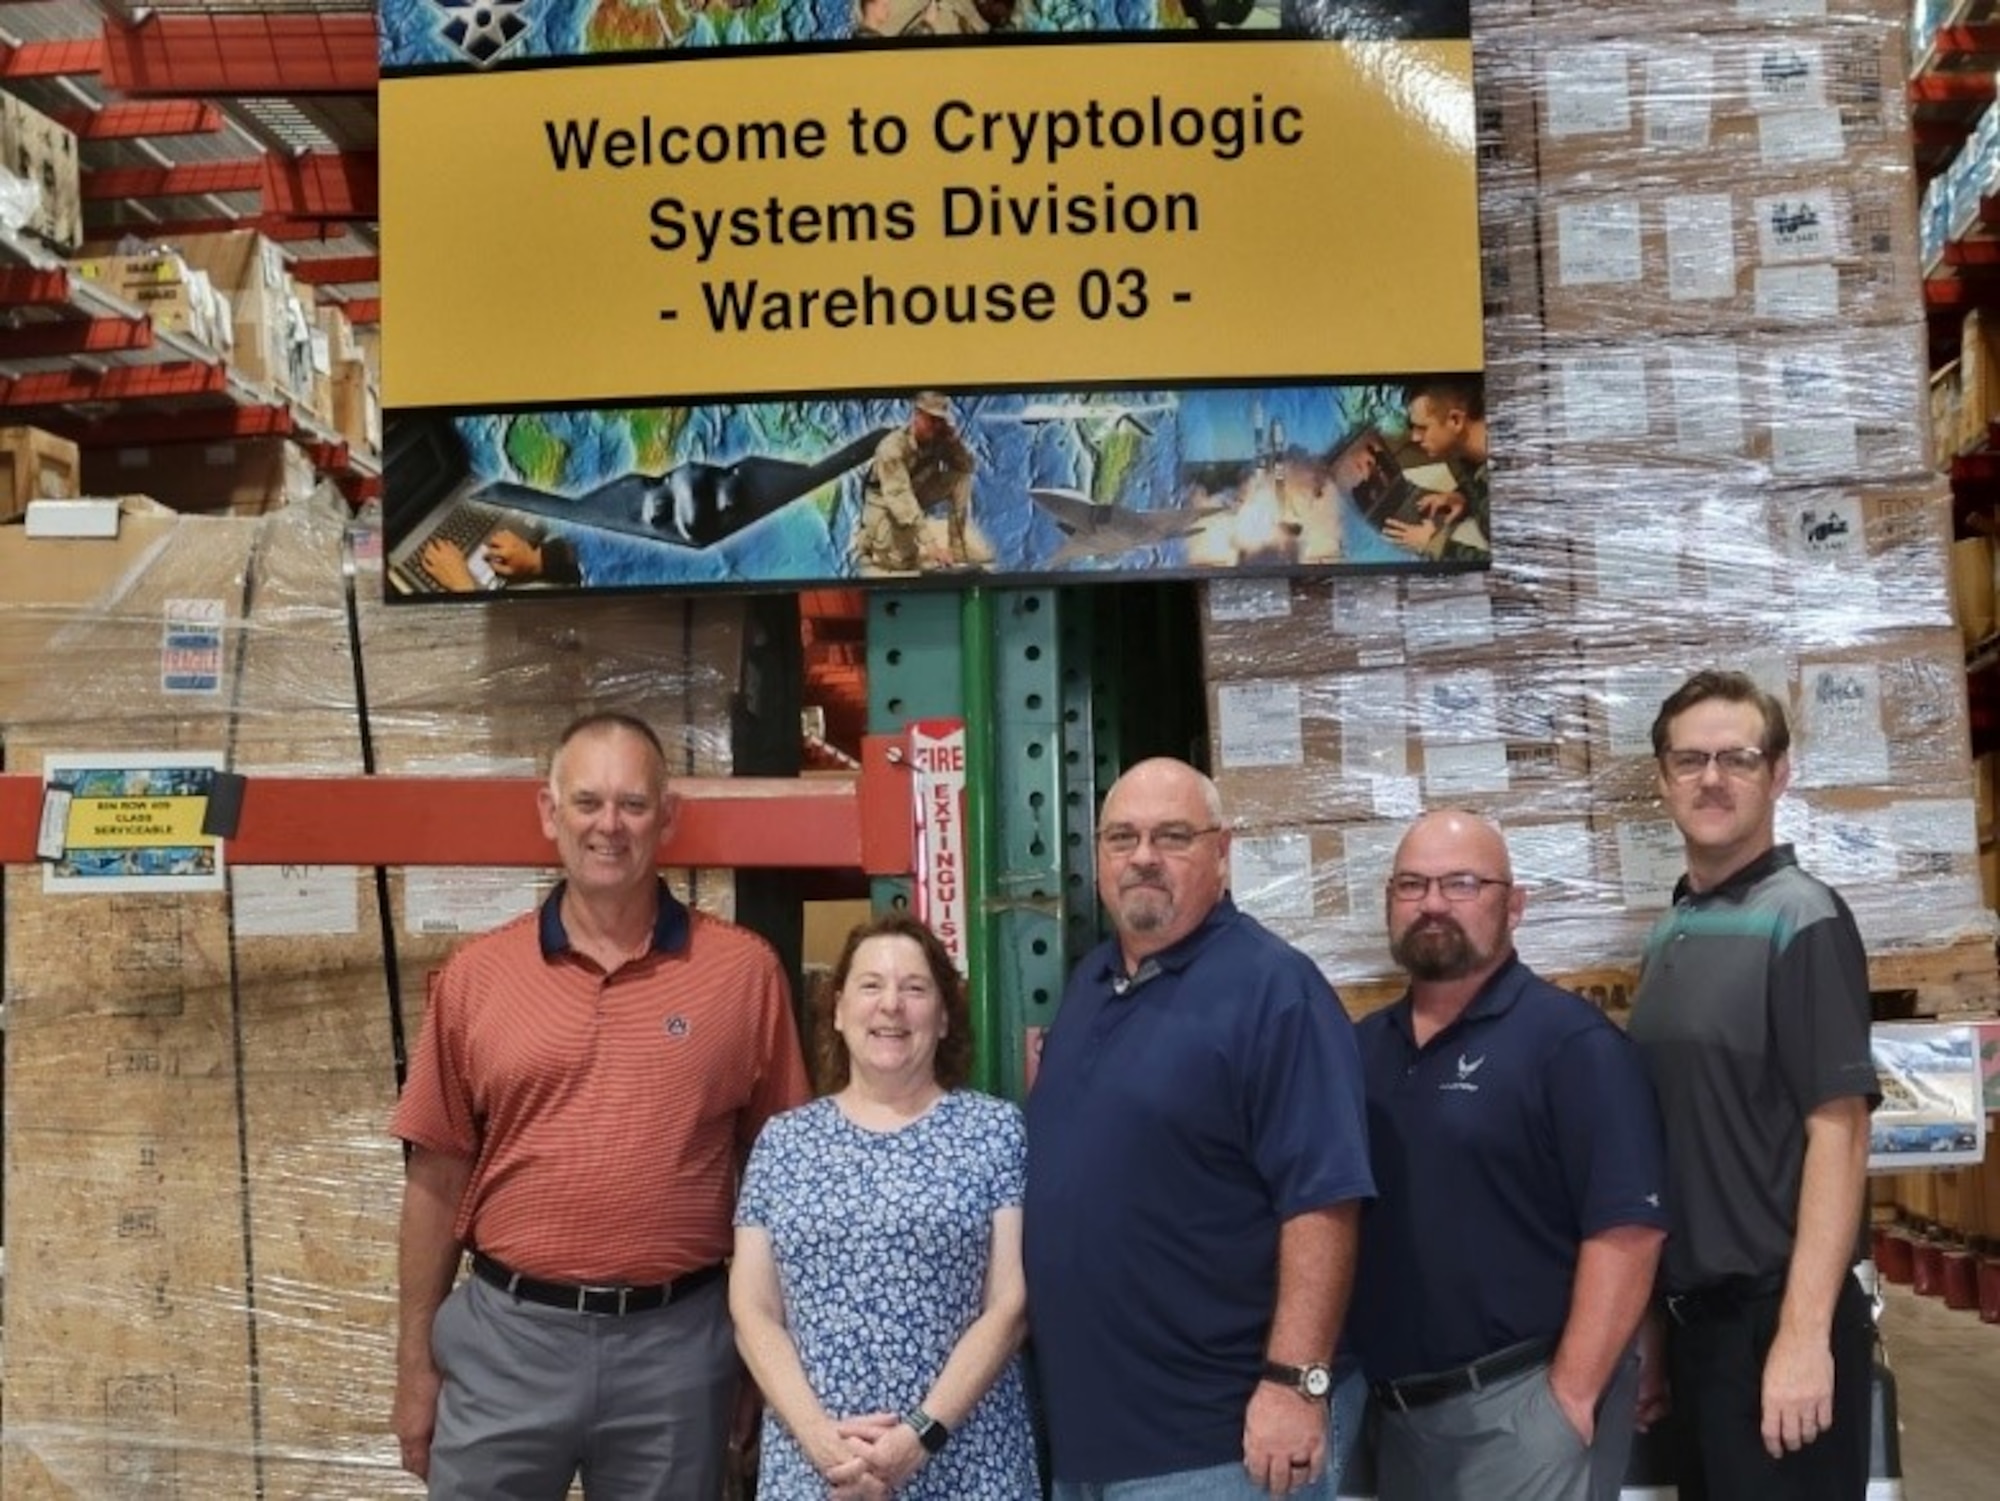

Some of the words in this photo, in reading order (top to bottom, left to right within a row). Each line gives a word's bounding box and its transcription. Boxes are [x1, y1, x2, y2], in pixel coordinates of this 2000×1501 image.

[543, 114, 828, 172] Welcome
[846, 107, 909, 157] to
[932, 94, 1305, 166] Cryptologic
[648, 196, 917, 264] Systems
[941, 183, 1200, 239] Division
[700, 274, 1057, 333] Warehouse
[1077, 267, 1150, 321] 03
[916, 744, 964, 773] FIRE
[120, 801, 147, 810] ROW
[94, 825, 173, 835] SERVICEABLE
